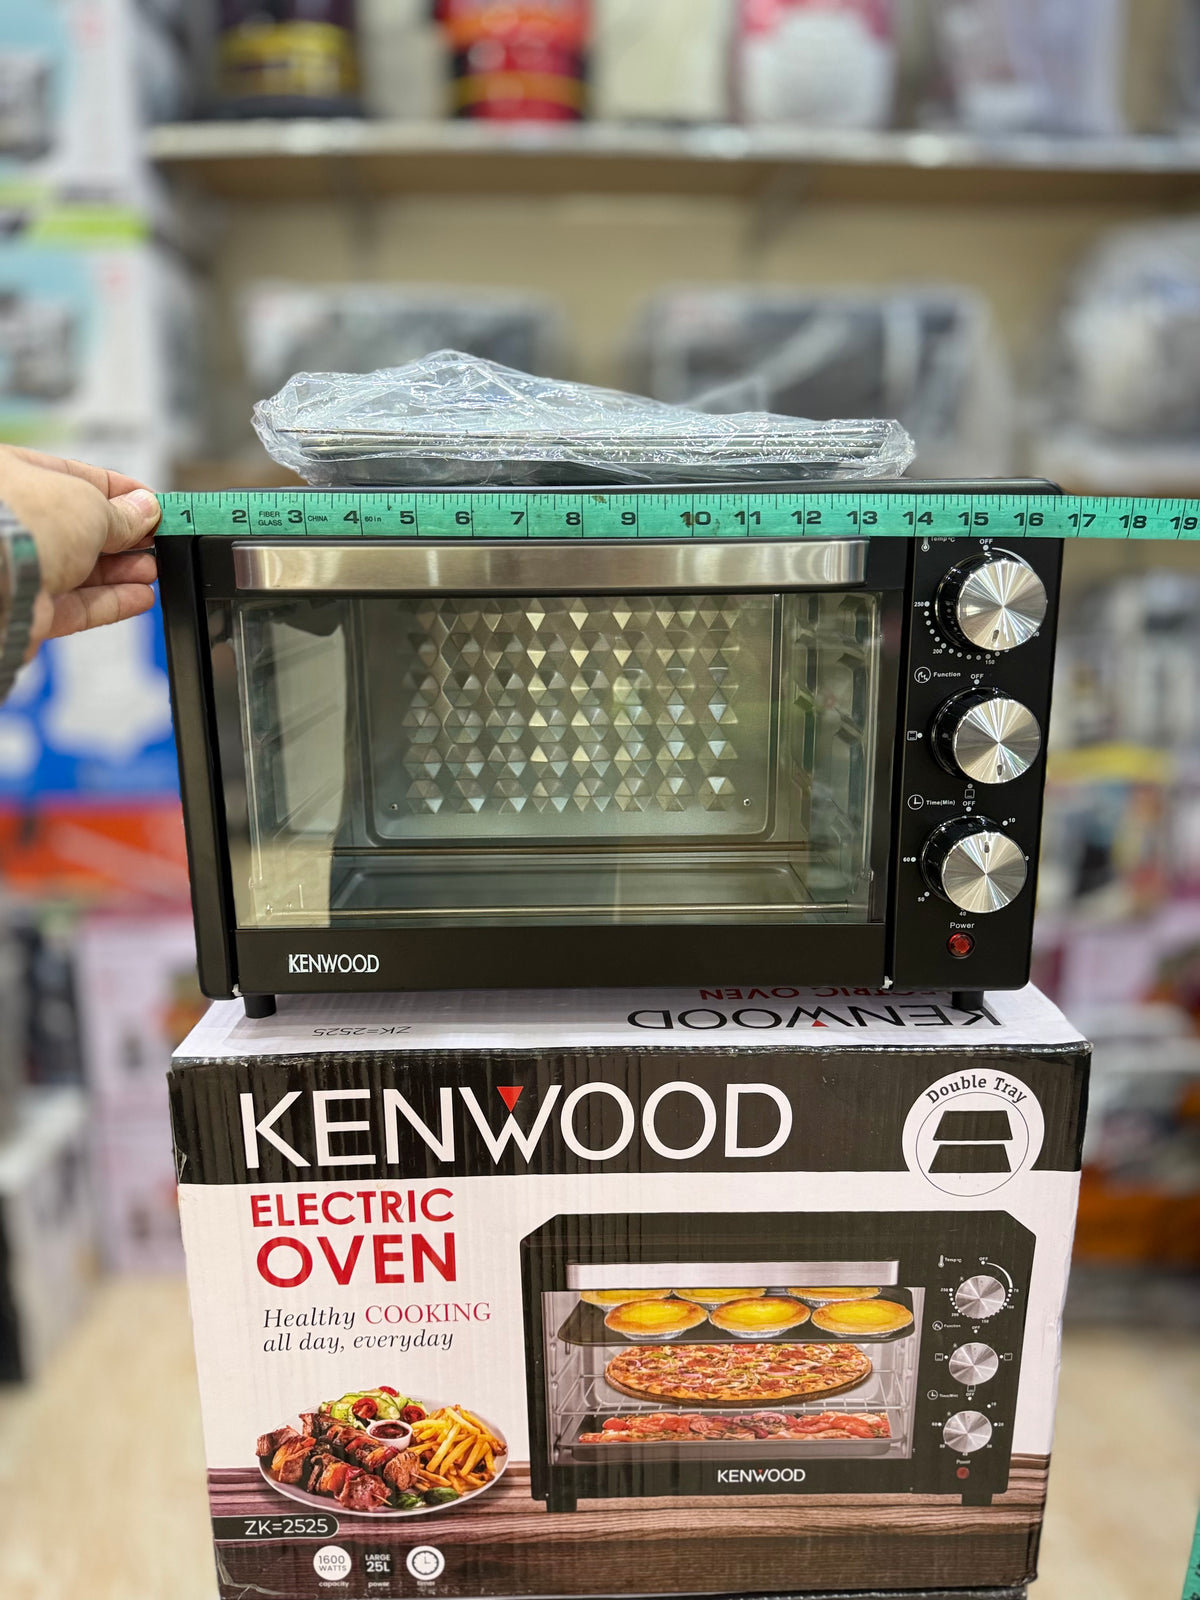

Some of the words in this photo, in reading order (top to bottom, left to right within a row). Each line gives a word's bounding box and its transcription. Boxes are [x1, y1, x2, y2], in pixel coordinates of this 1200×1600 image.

[180, 510, 191, 523] 1
[232, 510, 247, 523] 2
[288, 510, 303, 524] 3
[343, 510, 359, 524] 4
[400, 510, 415, 525] 5
[455, 511, 470, 525] 6
[510, 512, 525, 525] 7
[566, 512, 580, 525] 8
[621, 512, 636, 525] 9
[680, 512, 711, 526] 10
[734, 511, 761, 525] 11
[791, 511, 821, 525] 12
[847, 511, 877, 525] 13
[902, 511, 933, 525] 14
[958, 512, 989, 526] 15
[1013, 512, 1044, 526] 16
[1067, 513, 1097, 528] 17
[1119, 515, 1147, 529] 18
[1169, 515, 1198, 530] 19
[258, 519, 282, 527] GLASS
[288, 954, 380, 973] KENWOOD
[627, 1005, 1002, 1029] KENWOOD
[313, 1025, 411, 1037] ZK=2525
[925, 1075, 987, 1103] Double
[993, 1077, 1027, 1103] Tray
[240, 1081, 793, 1169] KENWOOD
[250, 1188, 454, 1227] ELECTRIC
[256, 1232, 456, 1288] OVEN
[263, 1306, 356, 1328] Healthy
[365, 1302, 491, 1324] COOKING
[263, 1334, 291, 1352] all
[299, 1333, 345, 1354] day,
[353, 1330, 453, 1351] everyday
[717, 1468, 806, 1483] KENWOOD
[244, 1519, 328, 1535] ZK=2525
[319, 1555, 345, 1565] 1600
[366, 1561, 390, 1572] 25L
